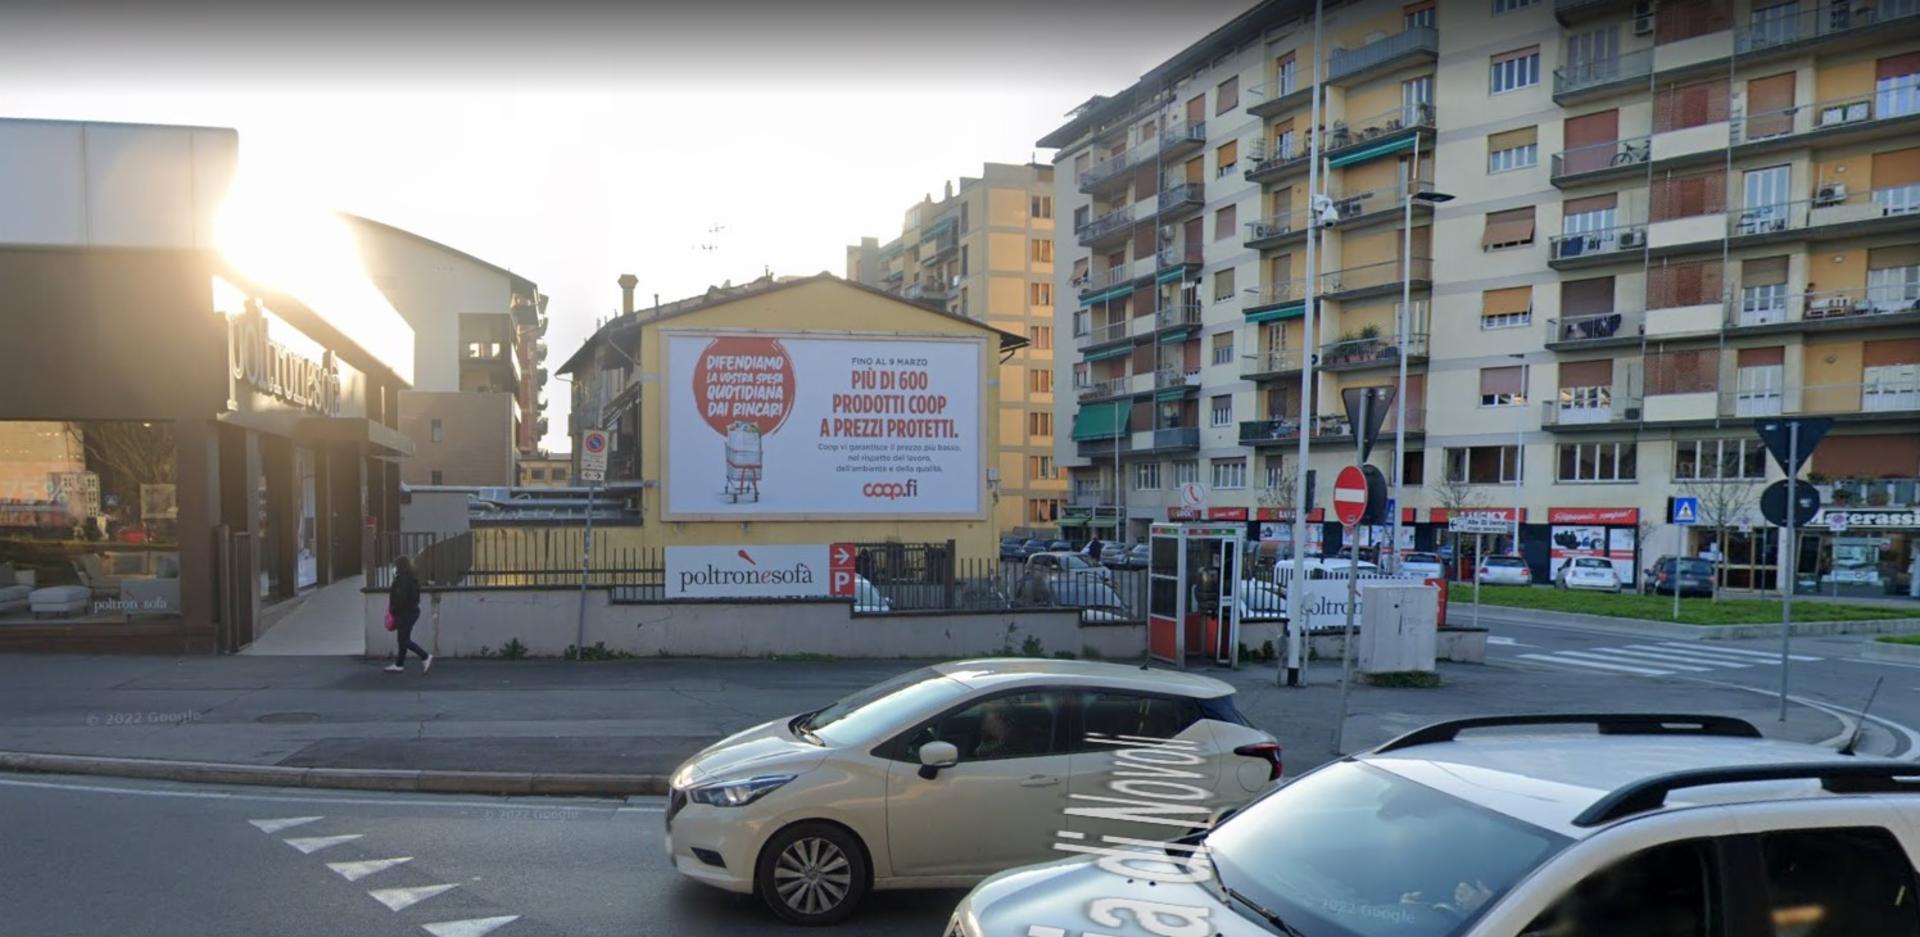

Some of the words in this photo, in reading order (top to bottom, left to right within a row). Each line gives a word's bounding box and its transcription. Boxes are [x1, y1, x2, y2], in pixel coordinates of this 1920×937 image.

[706, 355, 784, 371] DIFENDIAMO
[851, 357, 873, 366] FINO
[876, 358, 887, 366] AL
[889, 359, 895, 367] 9
[897, 359, 928, 367] MARZO
[706, 372, 718, 384] LA
[720, 372, 754, 384] VOSTRA
[756, 373, 784, 384] SPESA
[851, 367, 876, 390] PIÙ
[880, 370, 896, 390] DI
[899, 371, 928, 391] 600
[706, 385, 784, 401] QUOTIDIANA
[708, 402, 729, 417] DAI
[733, 402, 784, 418] RINCARI
[832, 394, 905, 414] PRODOTTI
[908, 395, 947, 415] COOP
[819, 418, 831, 438] A
[833, 418, 884, 438] PREZZI
[887, 419, 959, 438] PROTETTI.
[863, 479, 918, 500] coop.fi
[680, 563, 814, 593] poltronesofà
[834, 571, 849, 592] P
[1301, 596, 1363, 624] oltron
